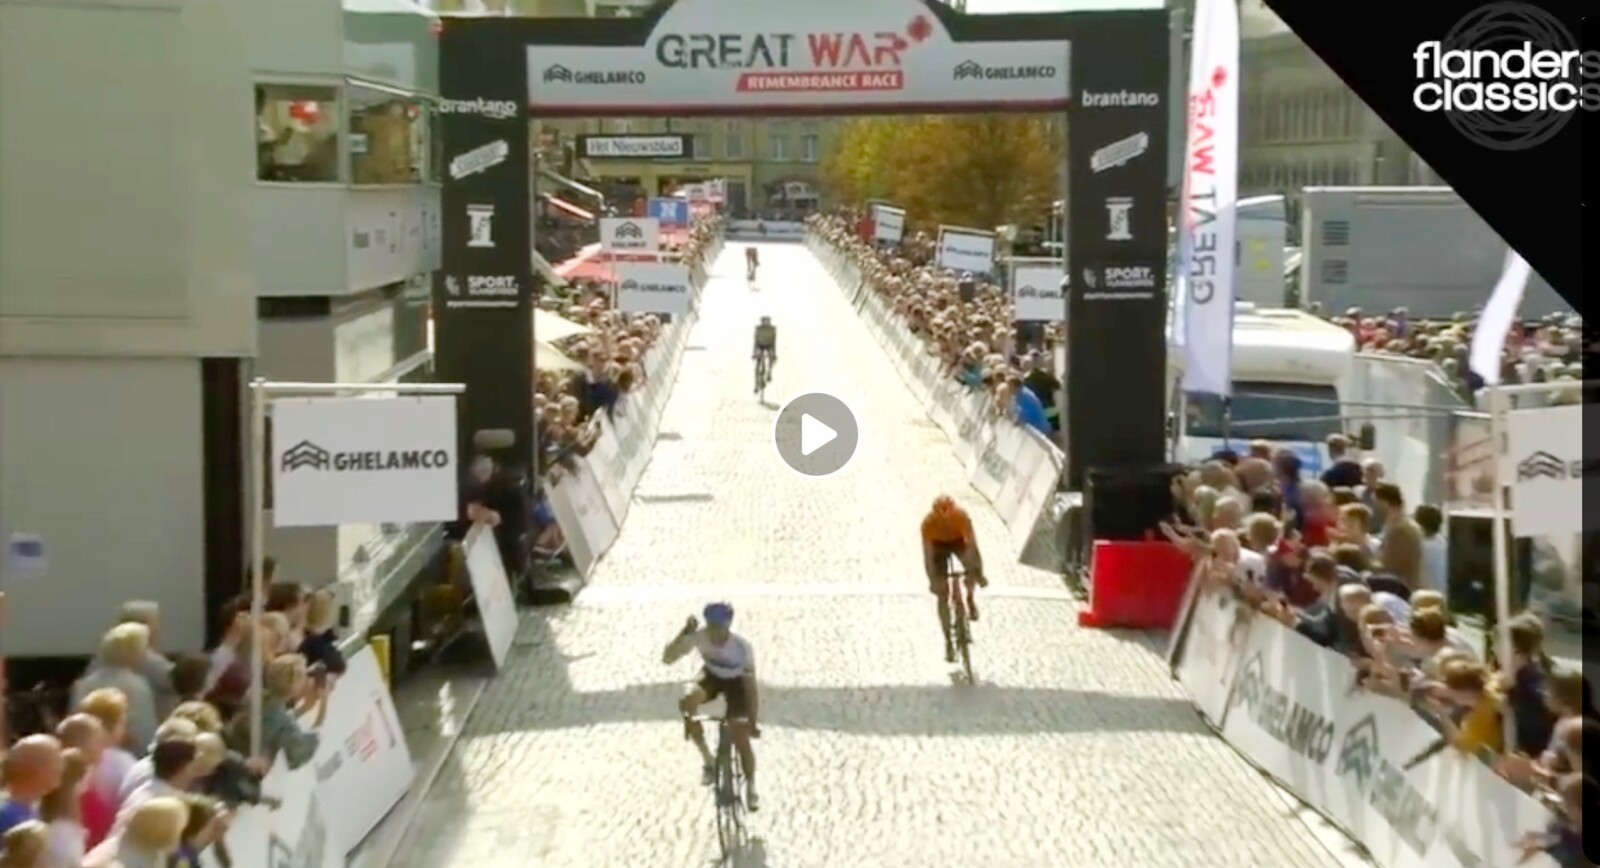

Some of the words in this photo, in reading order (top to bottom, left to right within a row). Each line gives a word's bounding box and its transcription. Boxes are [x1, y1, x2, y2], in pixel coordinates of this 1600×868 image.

[656, 33, 795, 68] GREAT
[808, 32, 904, 67] WAR
[574, 70, 646, 85] GHELAMCO
[747, 74, 857, 90] REMEMBRANCE
[862, 73, 899, 88] RACE
[984, 65, 1056, 80] GHELAMCO
[439, 95, 518, 113] brantano
[1082, 88, 1160, 107] brantano
[1190, 88, 1216, 175] WAR
[589, 140, 610, 153] Het
[612, 140, 680, 153] Nieuwsblad
[1189, 184, 1217, 305] GREAT
[334, 449, 449, 472] GHELAMCO
